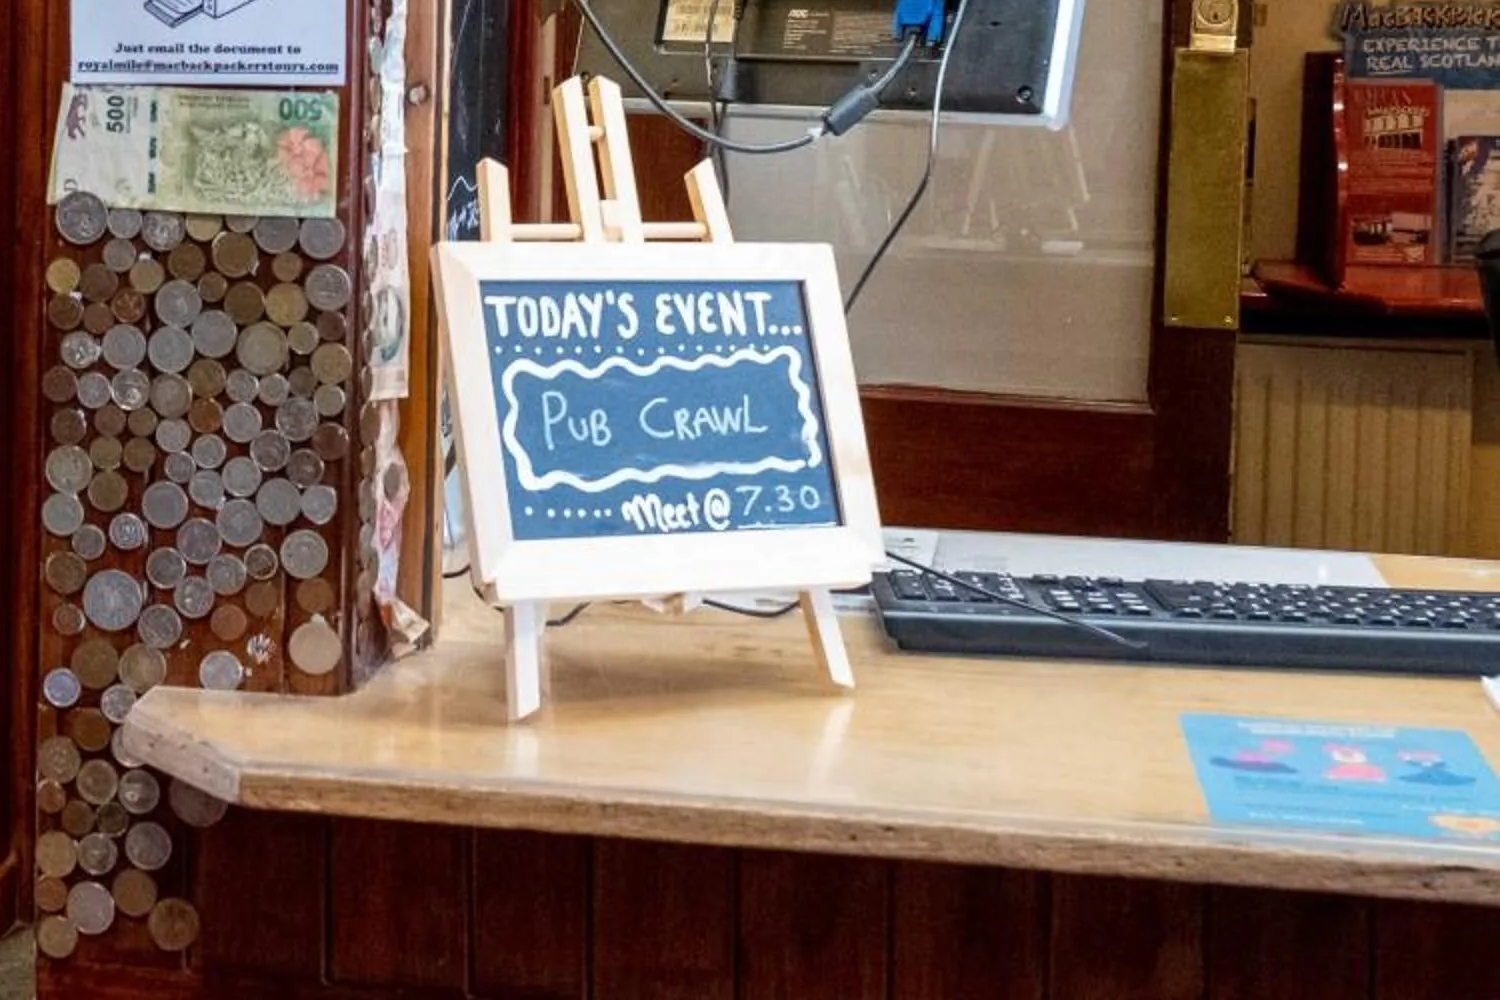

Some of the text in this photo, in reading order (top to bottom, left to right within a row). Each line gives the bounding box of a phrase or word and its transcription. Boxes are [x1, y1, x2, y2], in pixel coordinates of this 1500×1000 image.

[114, 42, 302, 55] Just email the document to
[1362, 37, 1482, 53] EXPERIENCE
[1366, 54, 1414, 71] REAL
[106, 94, 125, 134] 500
[483, 289, 639, 340] TODAY'S
[621, 494, 701, 533] Meet
[734, 484, 821, 517] 7.30
